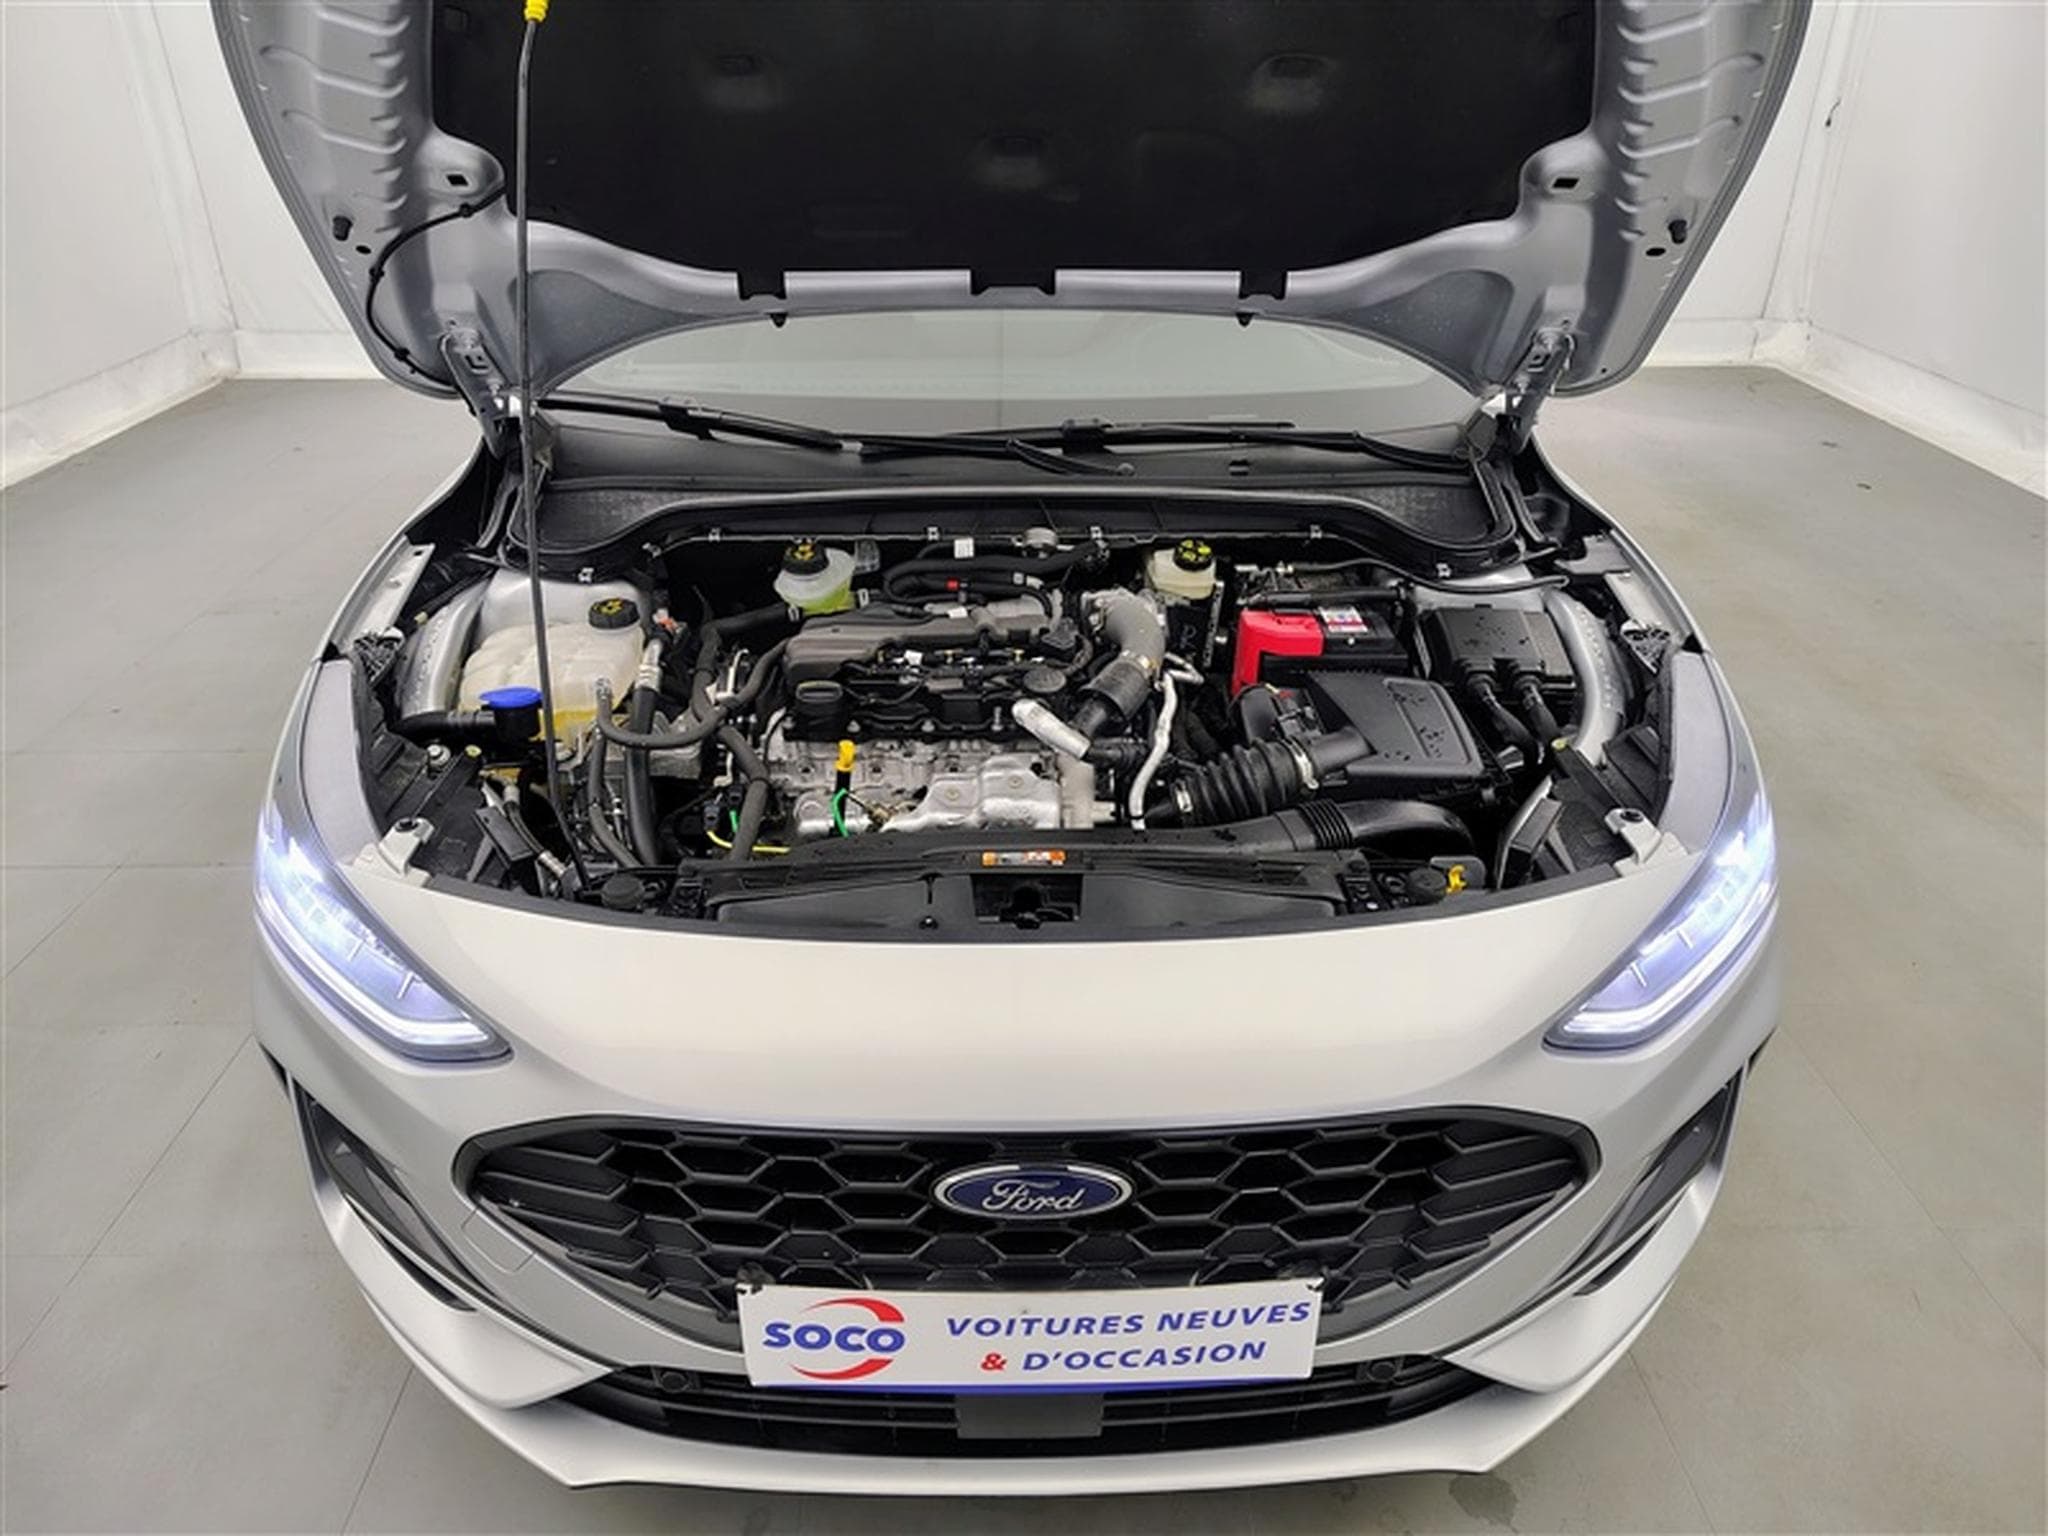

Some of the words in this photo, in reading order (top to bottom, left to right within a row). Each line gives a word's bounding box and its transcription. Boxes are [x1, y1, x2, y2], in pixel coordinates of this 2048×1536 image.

[982, 1179, 1086, 1211] Ford
[947, 1314, 1144, 1337] VOITURES
[1157, 1302, 1311, 1332] NEUVES
[763, 1322, 905, 1353] SOCO
[980, 1352, 1008, 1371] &
[1023, 1341, 1266, 1371] D'OCCASION
